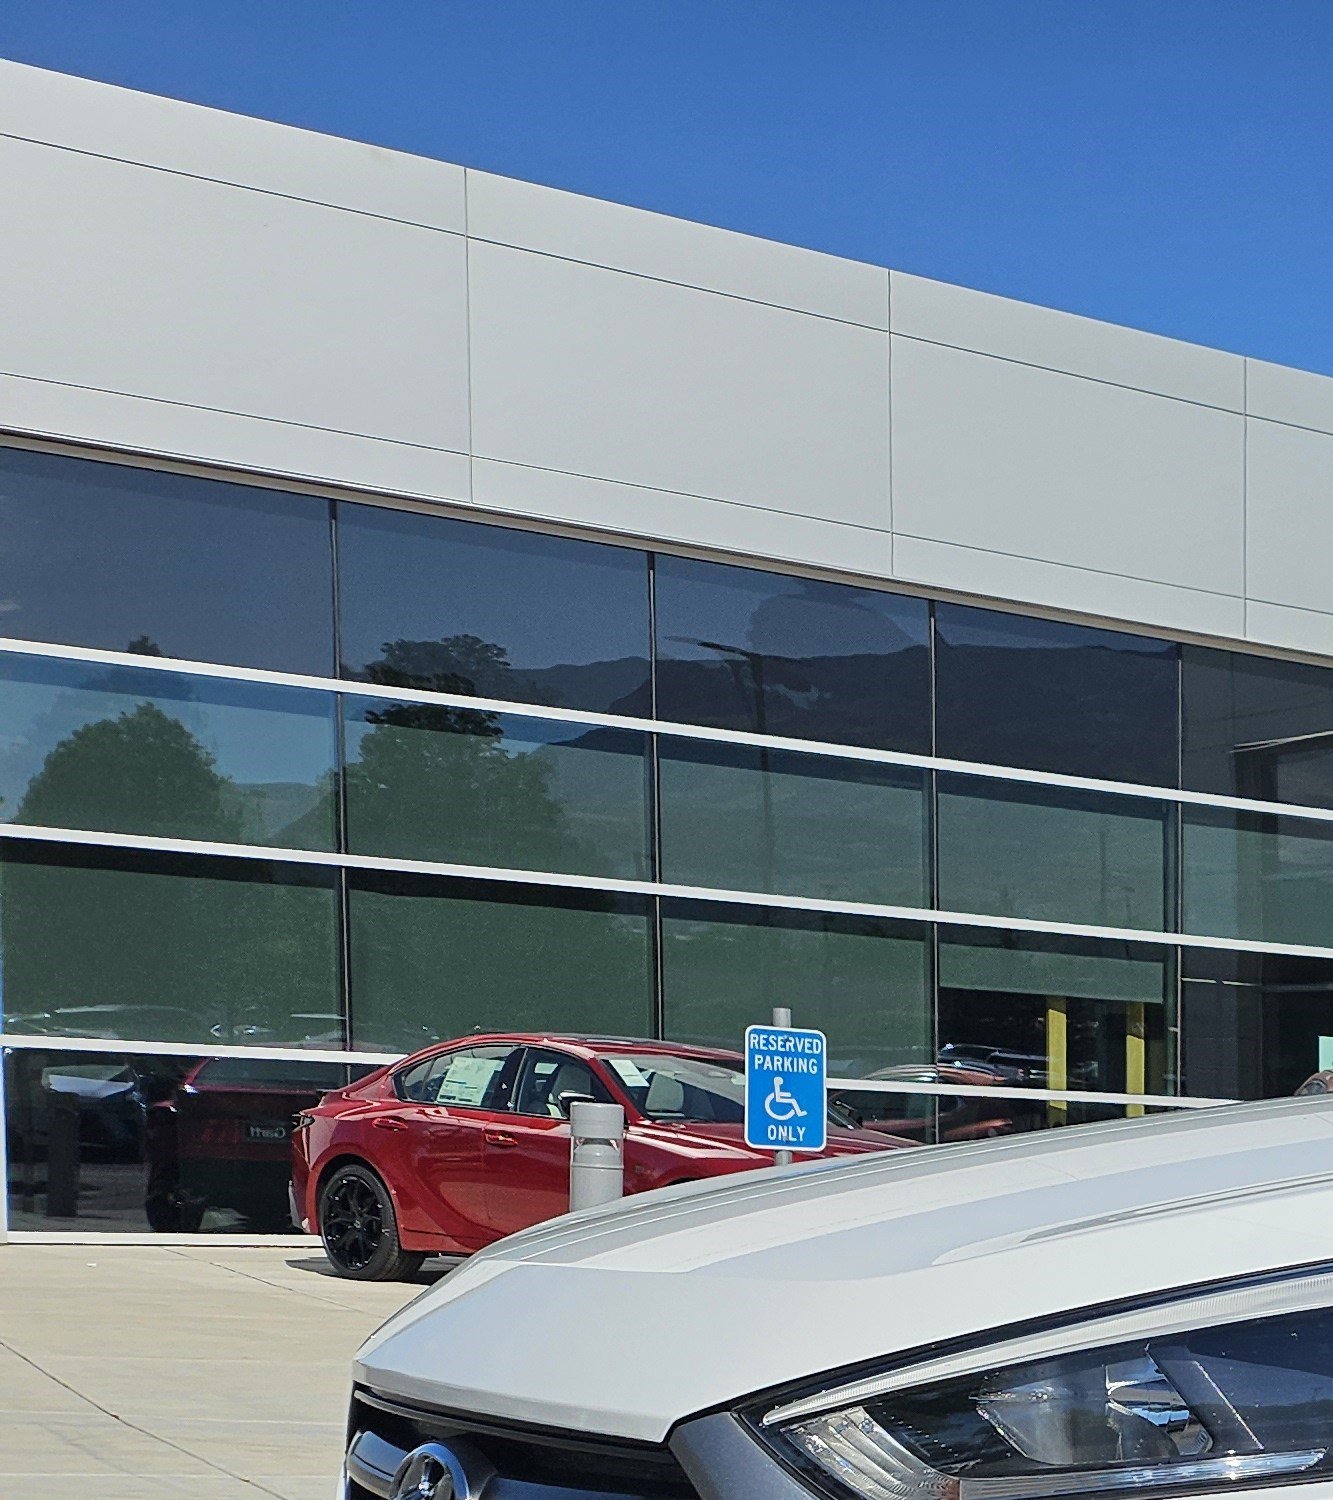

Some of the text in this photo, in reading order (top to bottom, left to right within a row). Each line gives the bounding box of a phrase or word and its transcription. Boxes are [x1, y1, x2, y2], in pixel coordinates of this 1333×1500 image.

[750, 1034, 822, 1054] RESERVED
[754, 1055, 818, 1074] PARKING
[767, 1125, 806, 1142] ONLY
